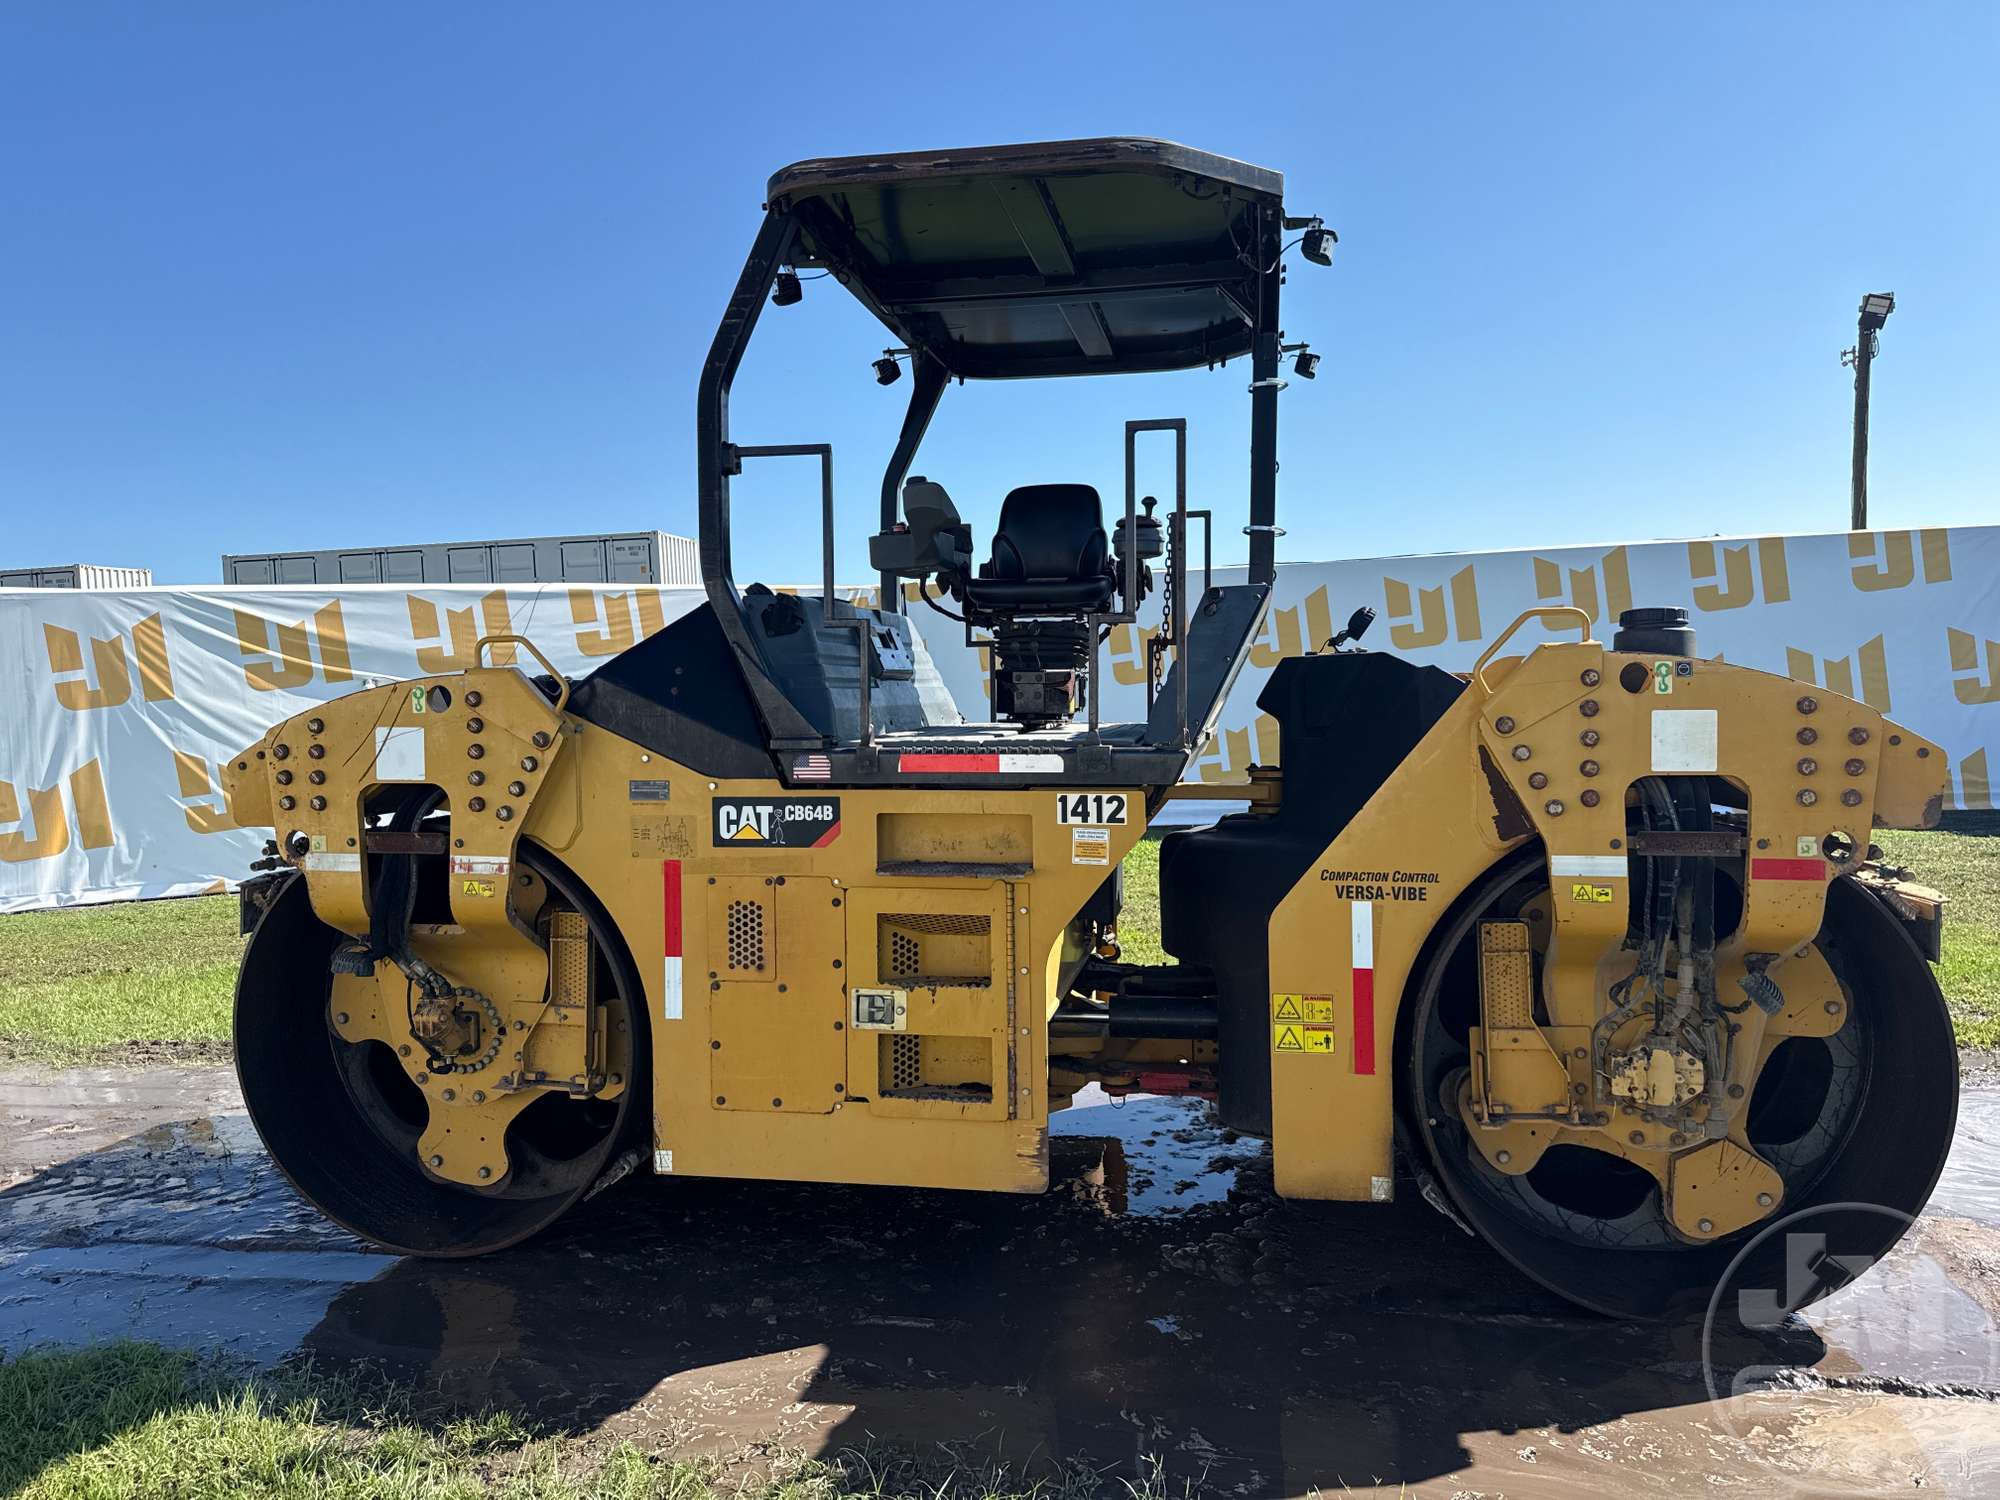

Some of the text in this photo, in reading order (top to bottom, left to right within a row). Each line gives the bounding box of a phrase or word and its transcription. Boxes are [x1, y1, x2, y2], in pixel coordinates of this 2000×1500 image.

[1058, 794, 1126, 824] 1412
[719, 804, 833, 840] CAT CB64B
[1320, 869, 1441, 884] COMPACTION CONTROL
[1335, 884, 1427, 901] VERSA-VIBE
